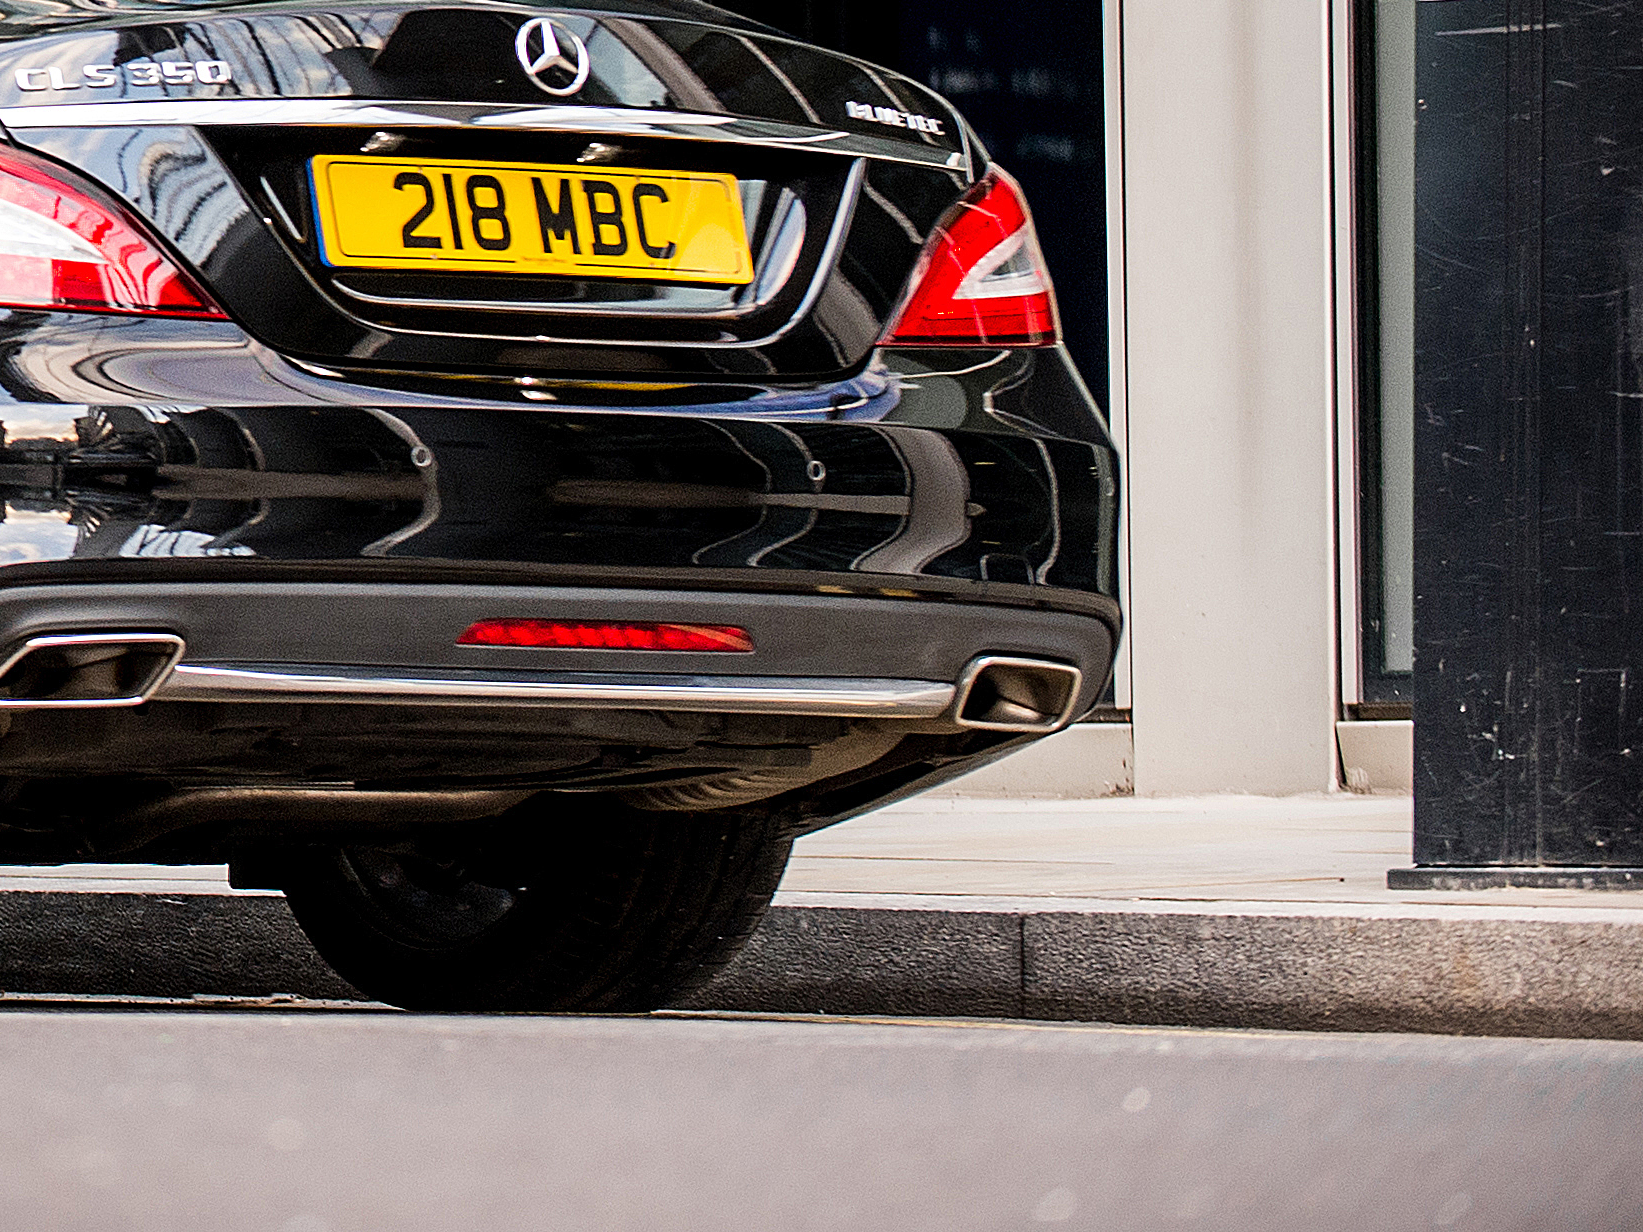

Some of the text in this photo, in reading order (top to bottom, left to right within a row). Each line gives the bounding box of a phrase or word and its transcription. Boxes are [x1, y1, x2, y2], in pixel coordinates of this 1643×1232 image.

[14, 60, 233, 92] CLS 350
[393, 172, 677, 259] 218 MBC
